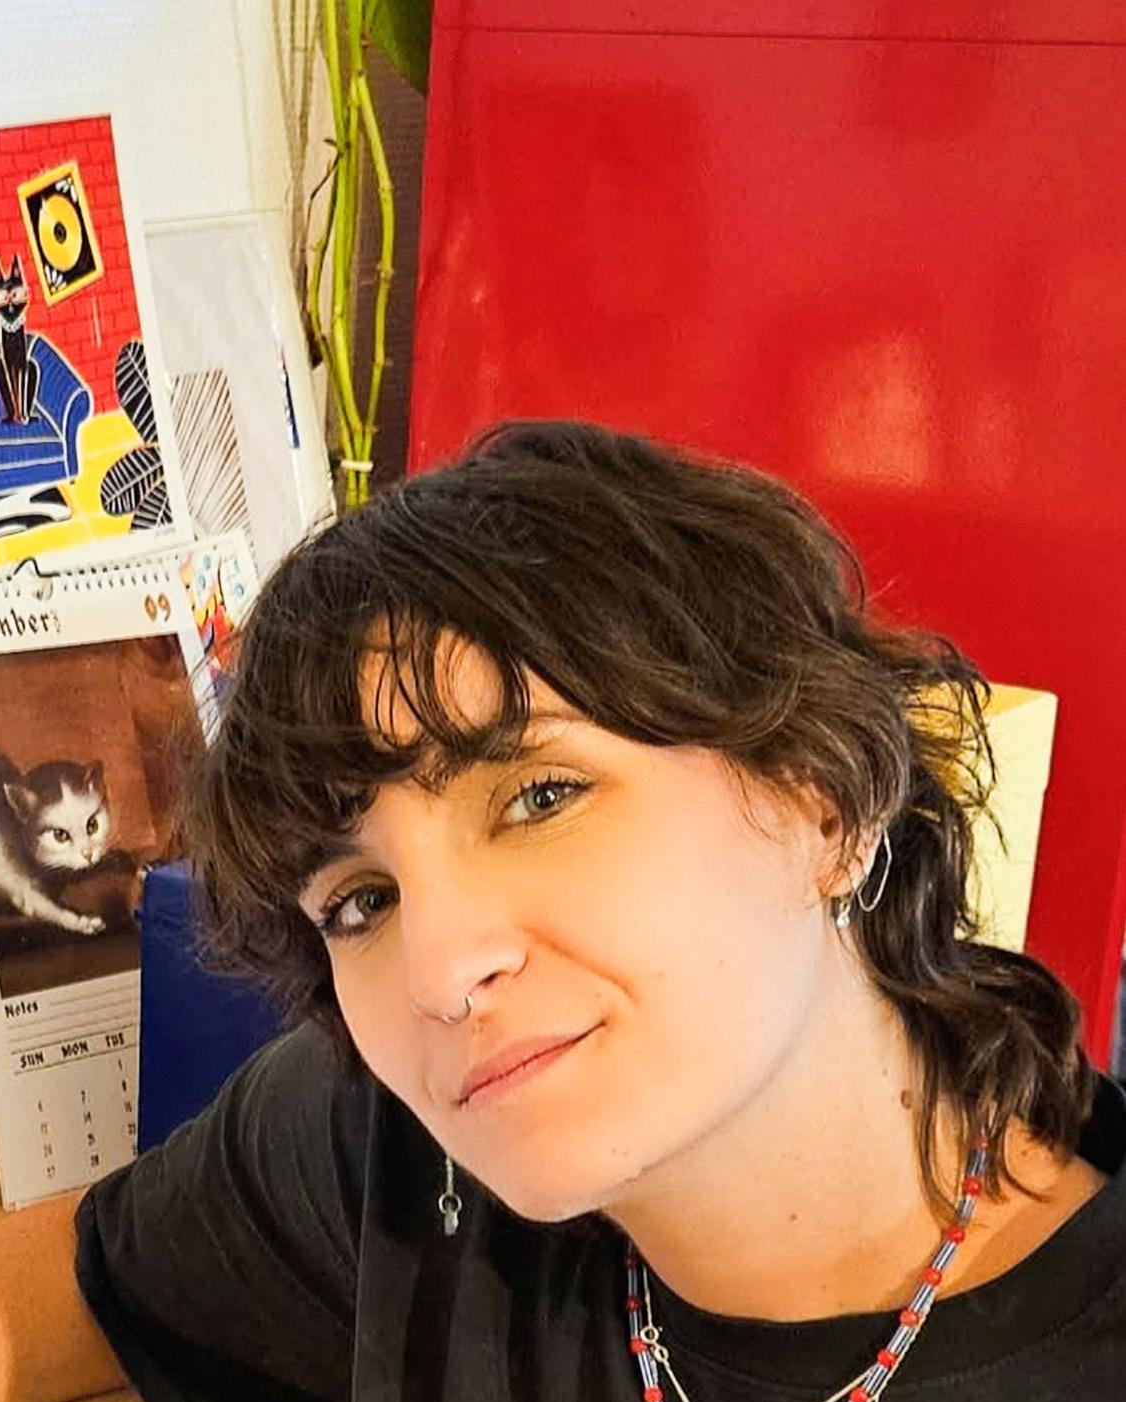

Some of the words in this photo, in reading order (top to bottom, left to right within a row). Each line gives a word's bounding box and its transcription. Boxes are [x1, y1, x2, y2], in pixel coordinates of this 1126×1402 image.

[144, 592, 172, 623] 09
[4, 1000, 39, 1019] Notes
[19, 1051, 45, 1069] SUN
[61, 1040, 90, 1058] MON
